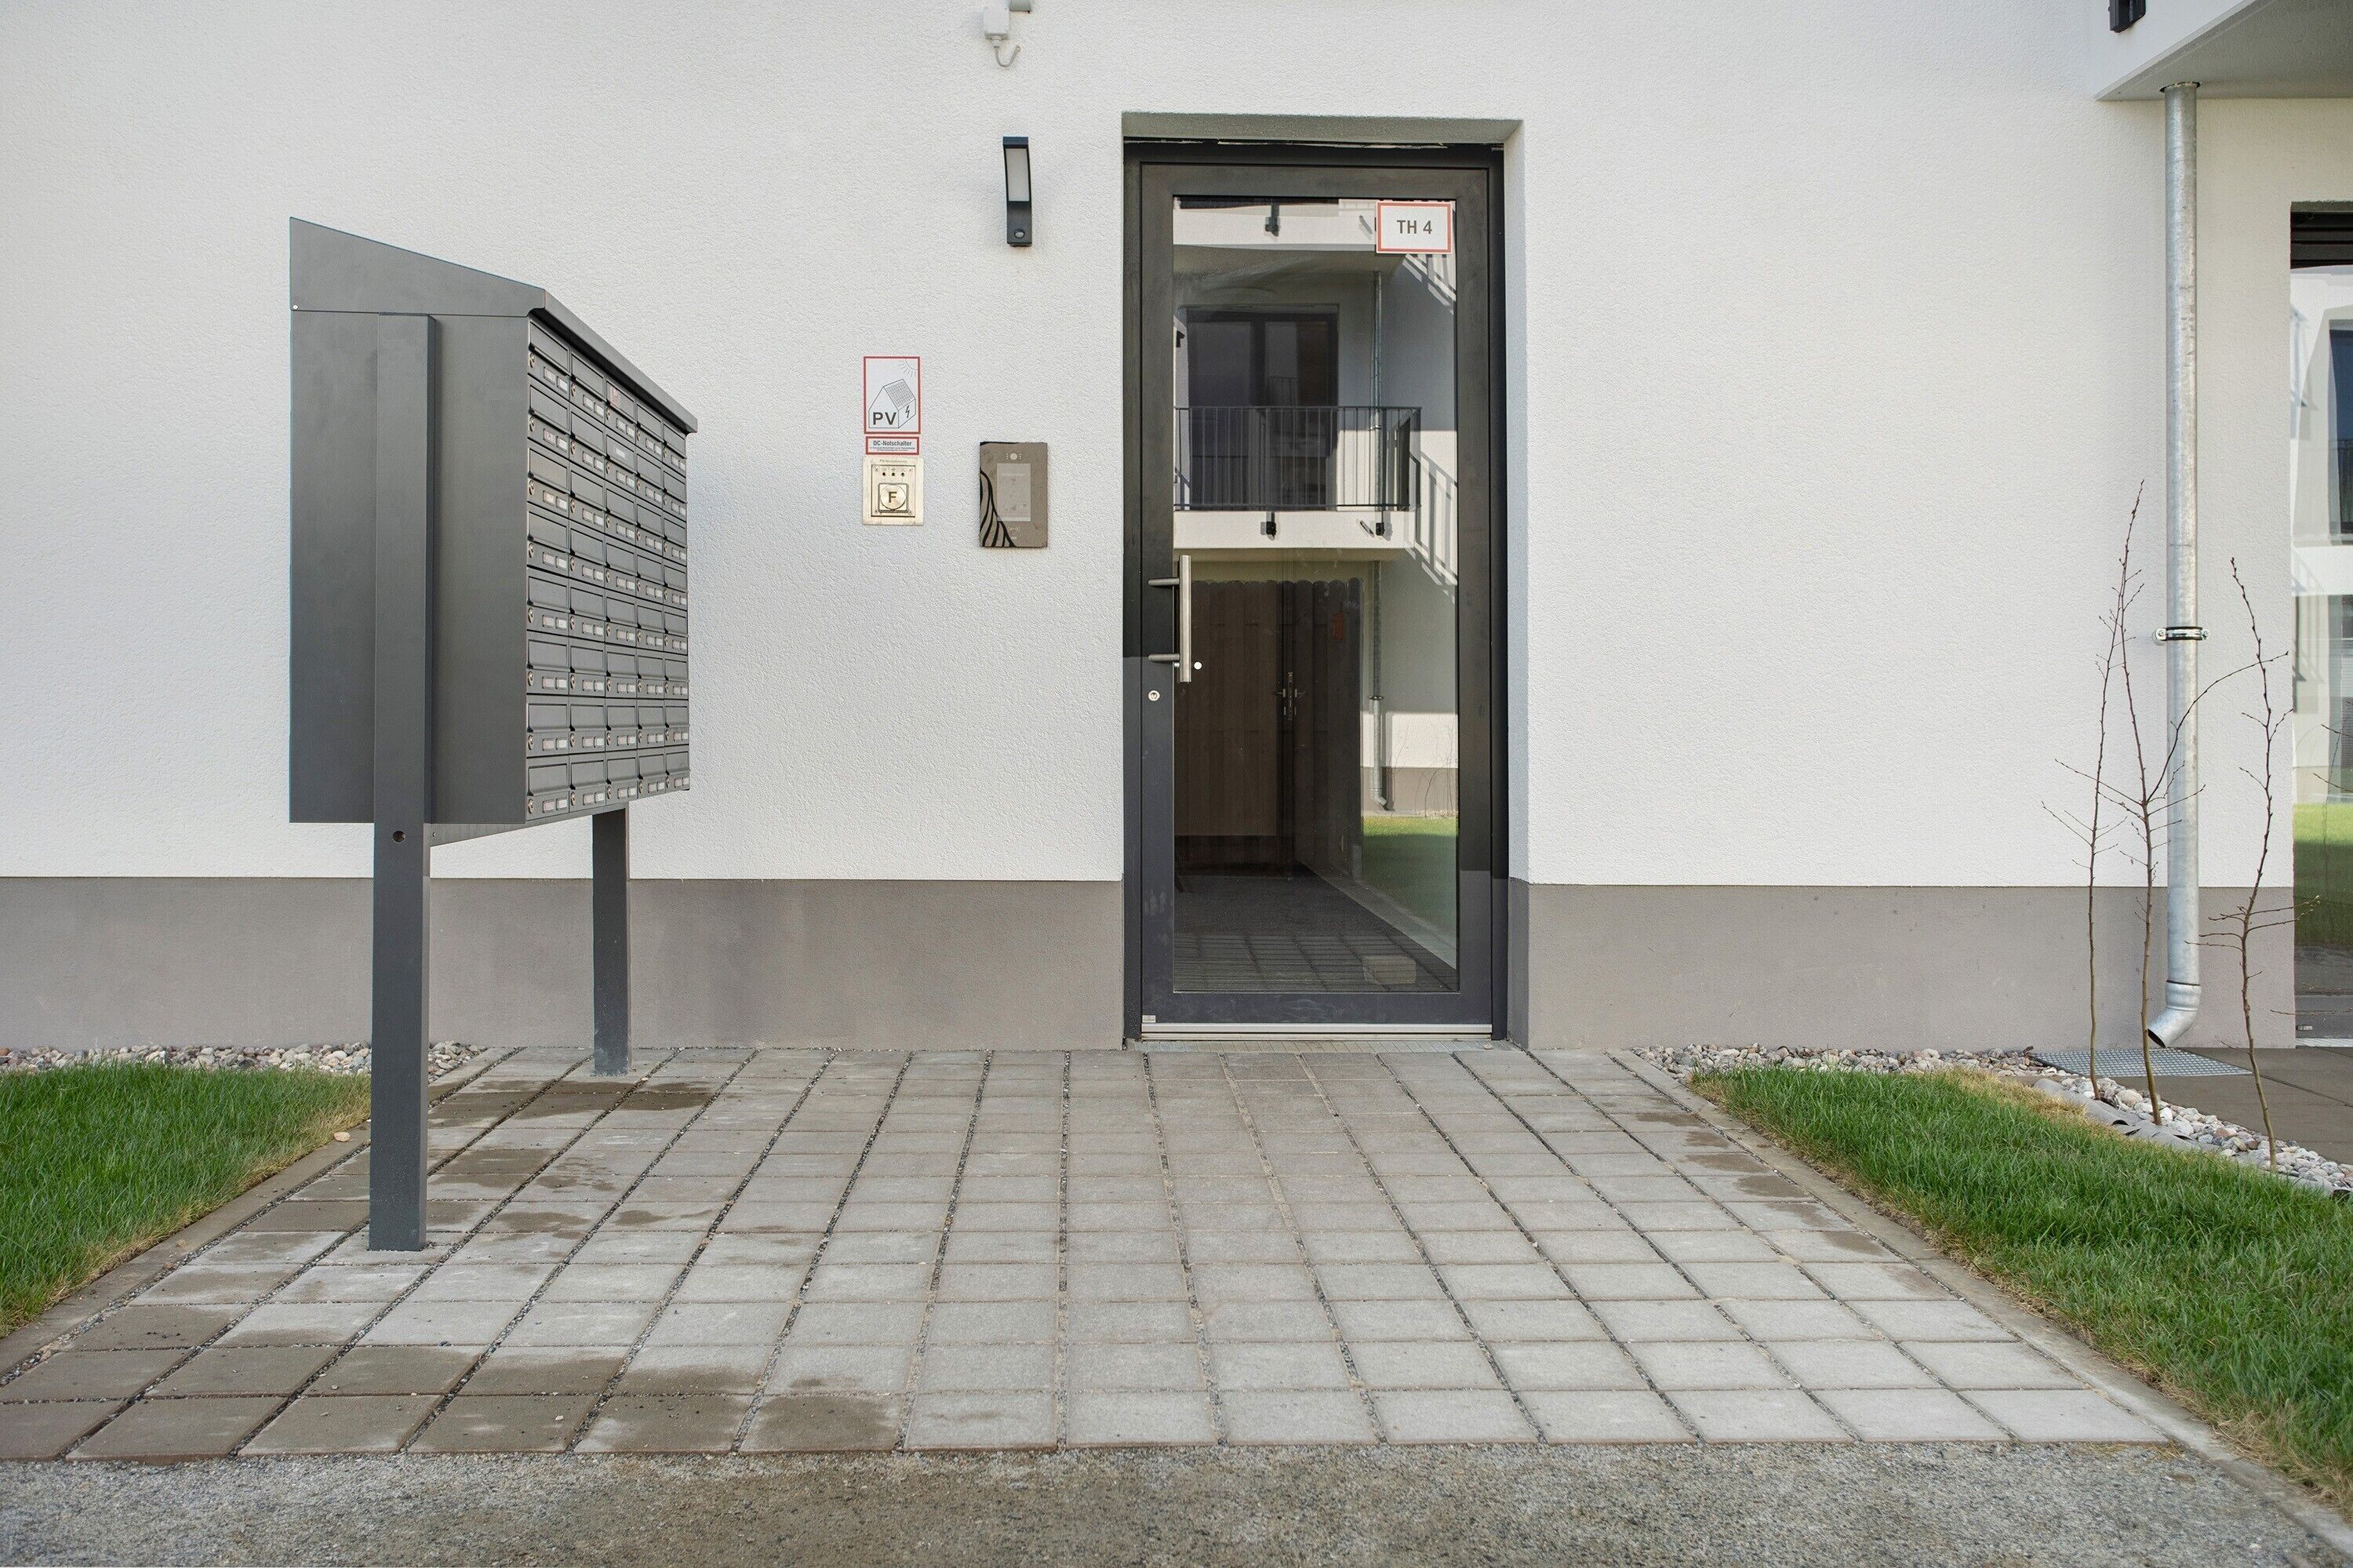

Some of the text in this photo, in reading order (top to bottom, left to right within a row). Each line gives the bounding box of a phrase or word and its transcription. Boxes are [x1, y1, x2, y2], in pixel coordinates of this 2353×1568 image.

[1396, 220, 1433, 235] TH 4
[873, 412, 897, 425] PV
[888, 491, 897, 504] F
